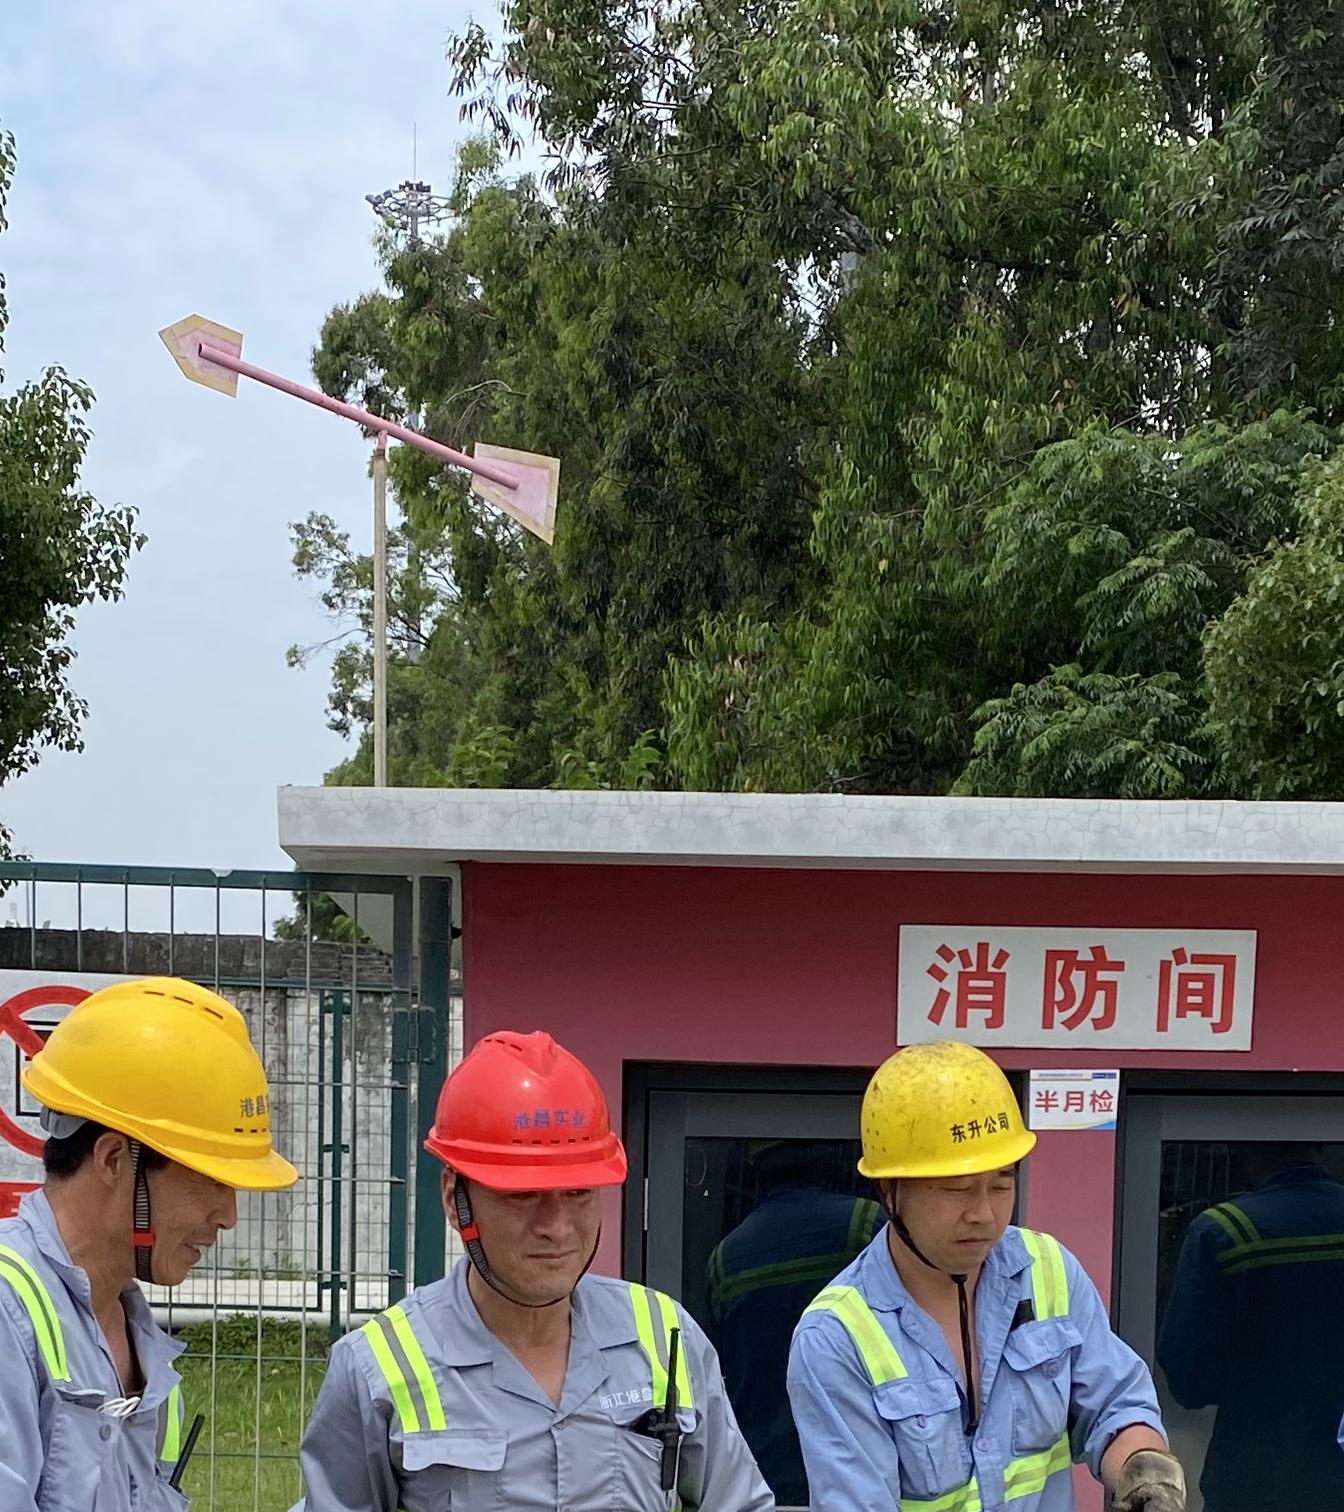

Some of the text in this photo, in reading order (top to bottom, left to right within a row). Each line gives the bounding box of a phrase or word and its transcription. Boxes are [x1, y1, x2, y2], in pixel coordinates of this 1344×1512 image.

[925, 941, 1238, 1035] 消防间
[1034, 1089, 1114, 1114] 半月检
[949, 1112, 1010, 1144] 东升公司
